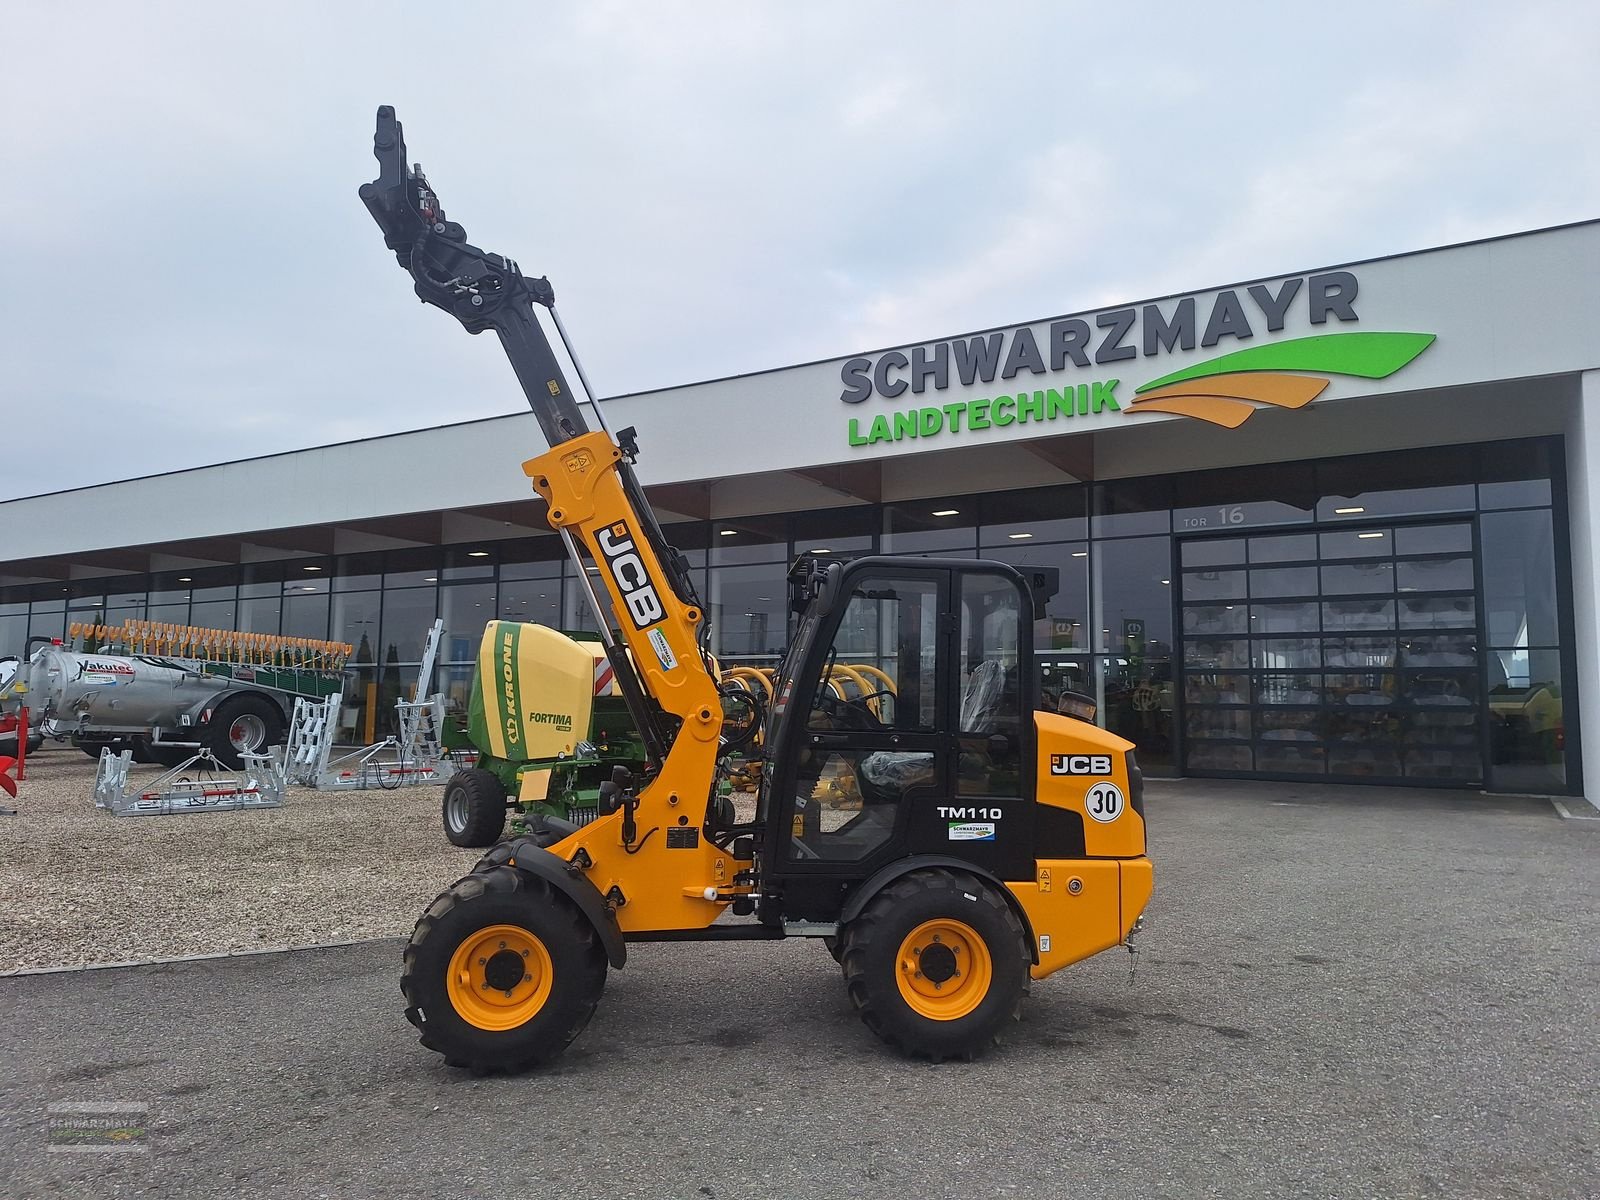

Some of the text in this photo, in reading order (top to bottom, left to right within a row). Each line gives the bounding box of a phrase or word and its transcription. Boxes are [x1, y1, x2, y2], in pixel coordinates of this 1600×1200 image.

[840, 271, 1359, 403] SCHWARZMAYR
[848, 379, 1122, 446] LANDTECHNIK
[1183, 506, 1244, 527] TOR 16
[599, 528, 662, 626] JCB
[503, 632, 516, 716] KRONE
[529, 712, 572, 726] FORTIMA
[1052, 756, 1111, 773] JCB
[937, 807, 1002, 819] TM110
[1093, 790, 1116, 814] 30
